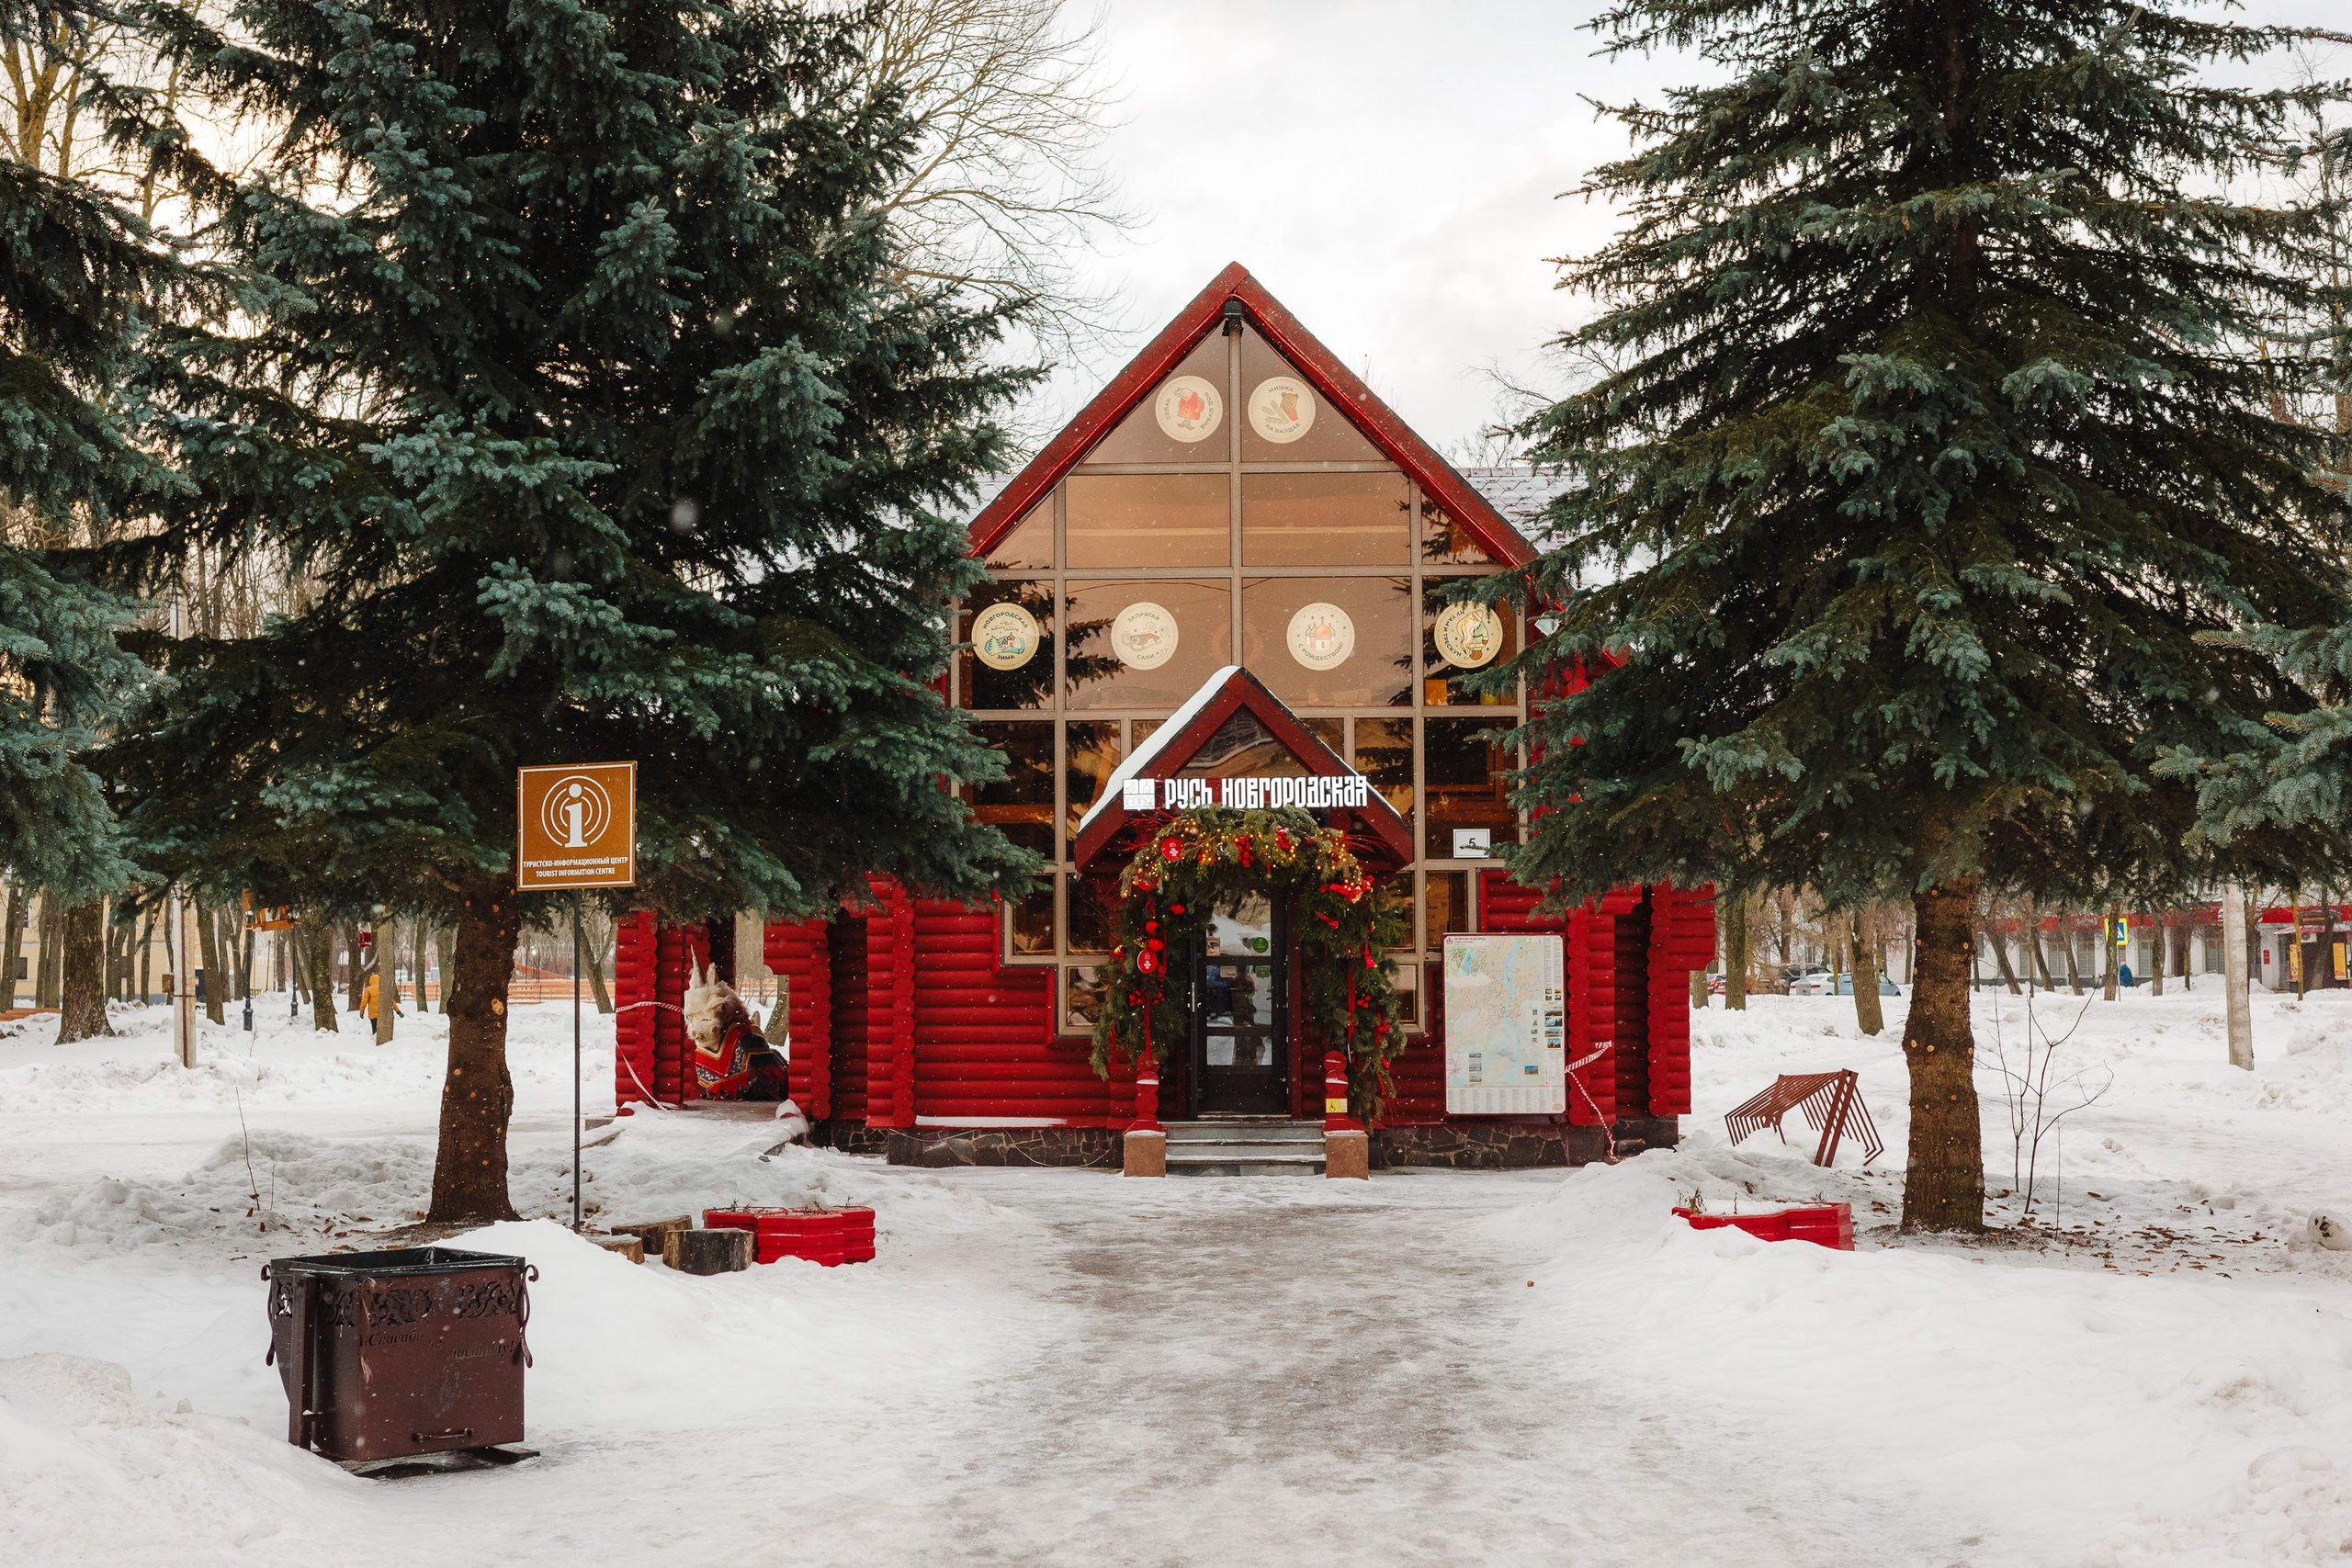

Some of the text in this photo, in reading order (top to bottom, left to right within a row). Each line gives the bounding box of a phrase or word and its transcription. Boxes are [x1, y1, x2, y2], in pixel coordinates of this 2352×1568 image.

[1268, 385, 1294, 393] МИШКА
[1204, 391, 1214, 406] ПОД
[1265, 423, 1274, 432] НА
[982, 611, 1029, 629] НОВГОРОДСКАЯ
[1127, 612, 1160, 623] ЗАПРЯГАЙ
[1444, 615, 1456, 627] ТАМ
[1301, 641, 1344, 661] РОЖДЕСТВОМ!
[1442, 632, 1462, 658] ТРЕСКУН
[1164, 778, 1213, 809] РУСЬ
[1468, 837, 1476, 848] 5
[523, 856, 628, 868] ТУРИСТСКО-ИНФОРМАЦИОННЫЙ ЦЕНТР
[536, 867, 616, 878] TOURIST INFORMATION CENTRE
